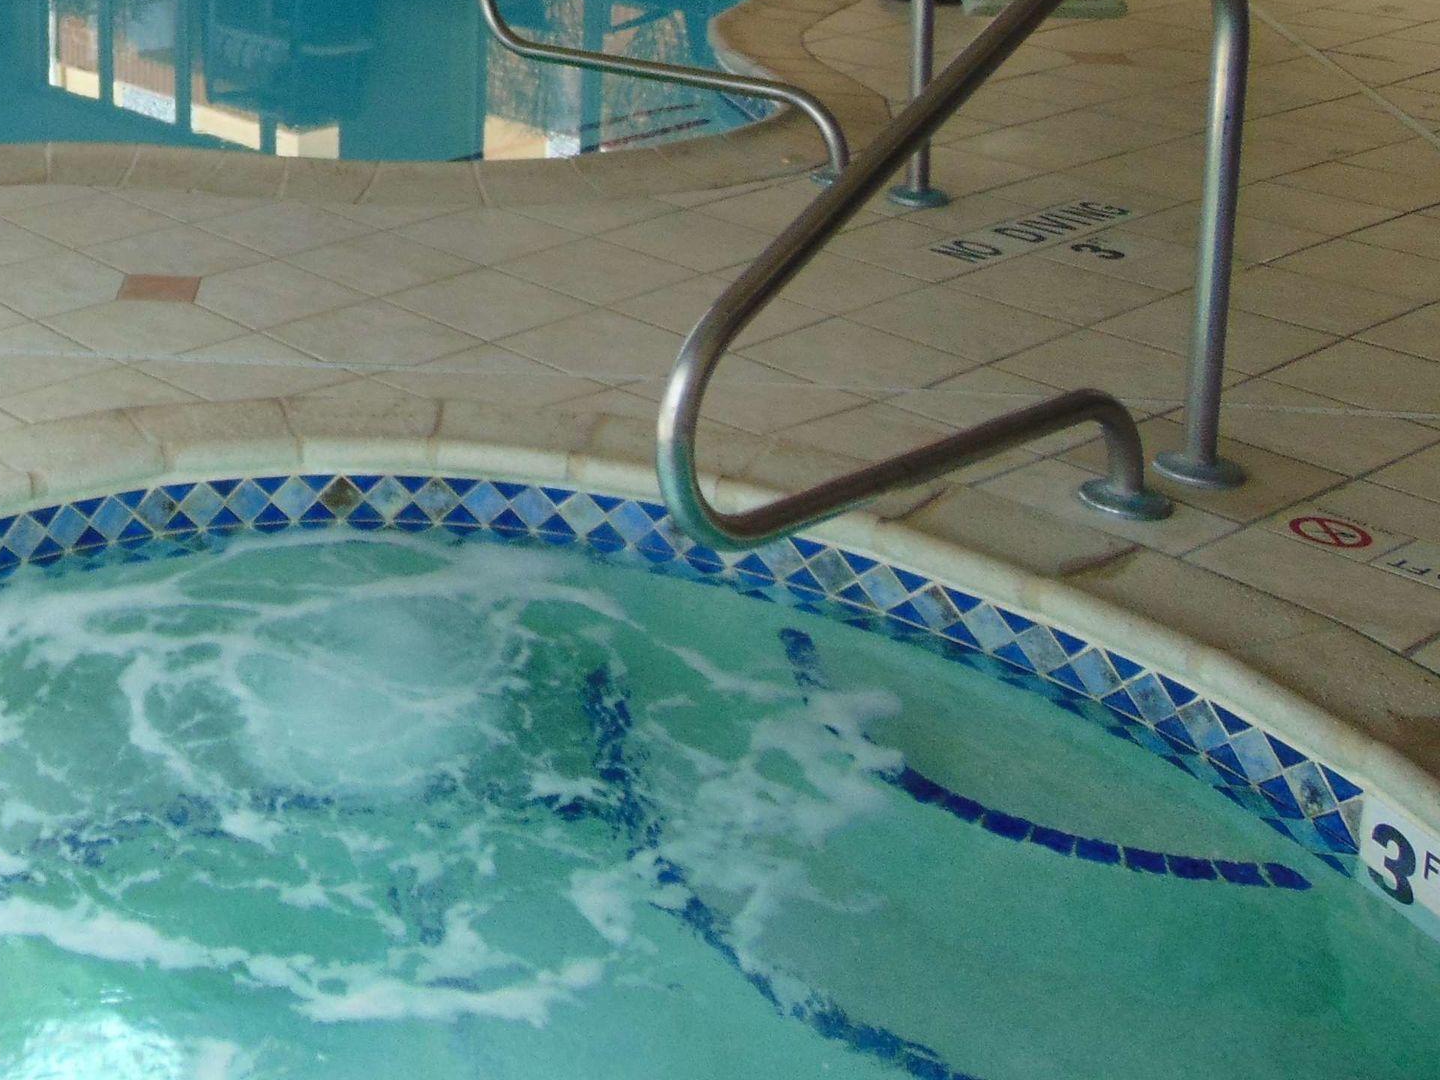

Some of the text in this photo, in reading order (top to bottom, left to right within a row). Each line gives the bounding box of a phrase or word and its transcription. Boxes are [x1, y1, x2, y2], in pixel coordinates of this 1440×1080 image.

[930, 201, 1131, 263] NO DIVING
[1071, 243, 1125, 260] 3
[1367, 823, 1416, 905] 3
